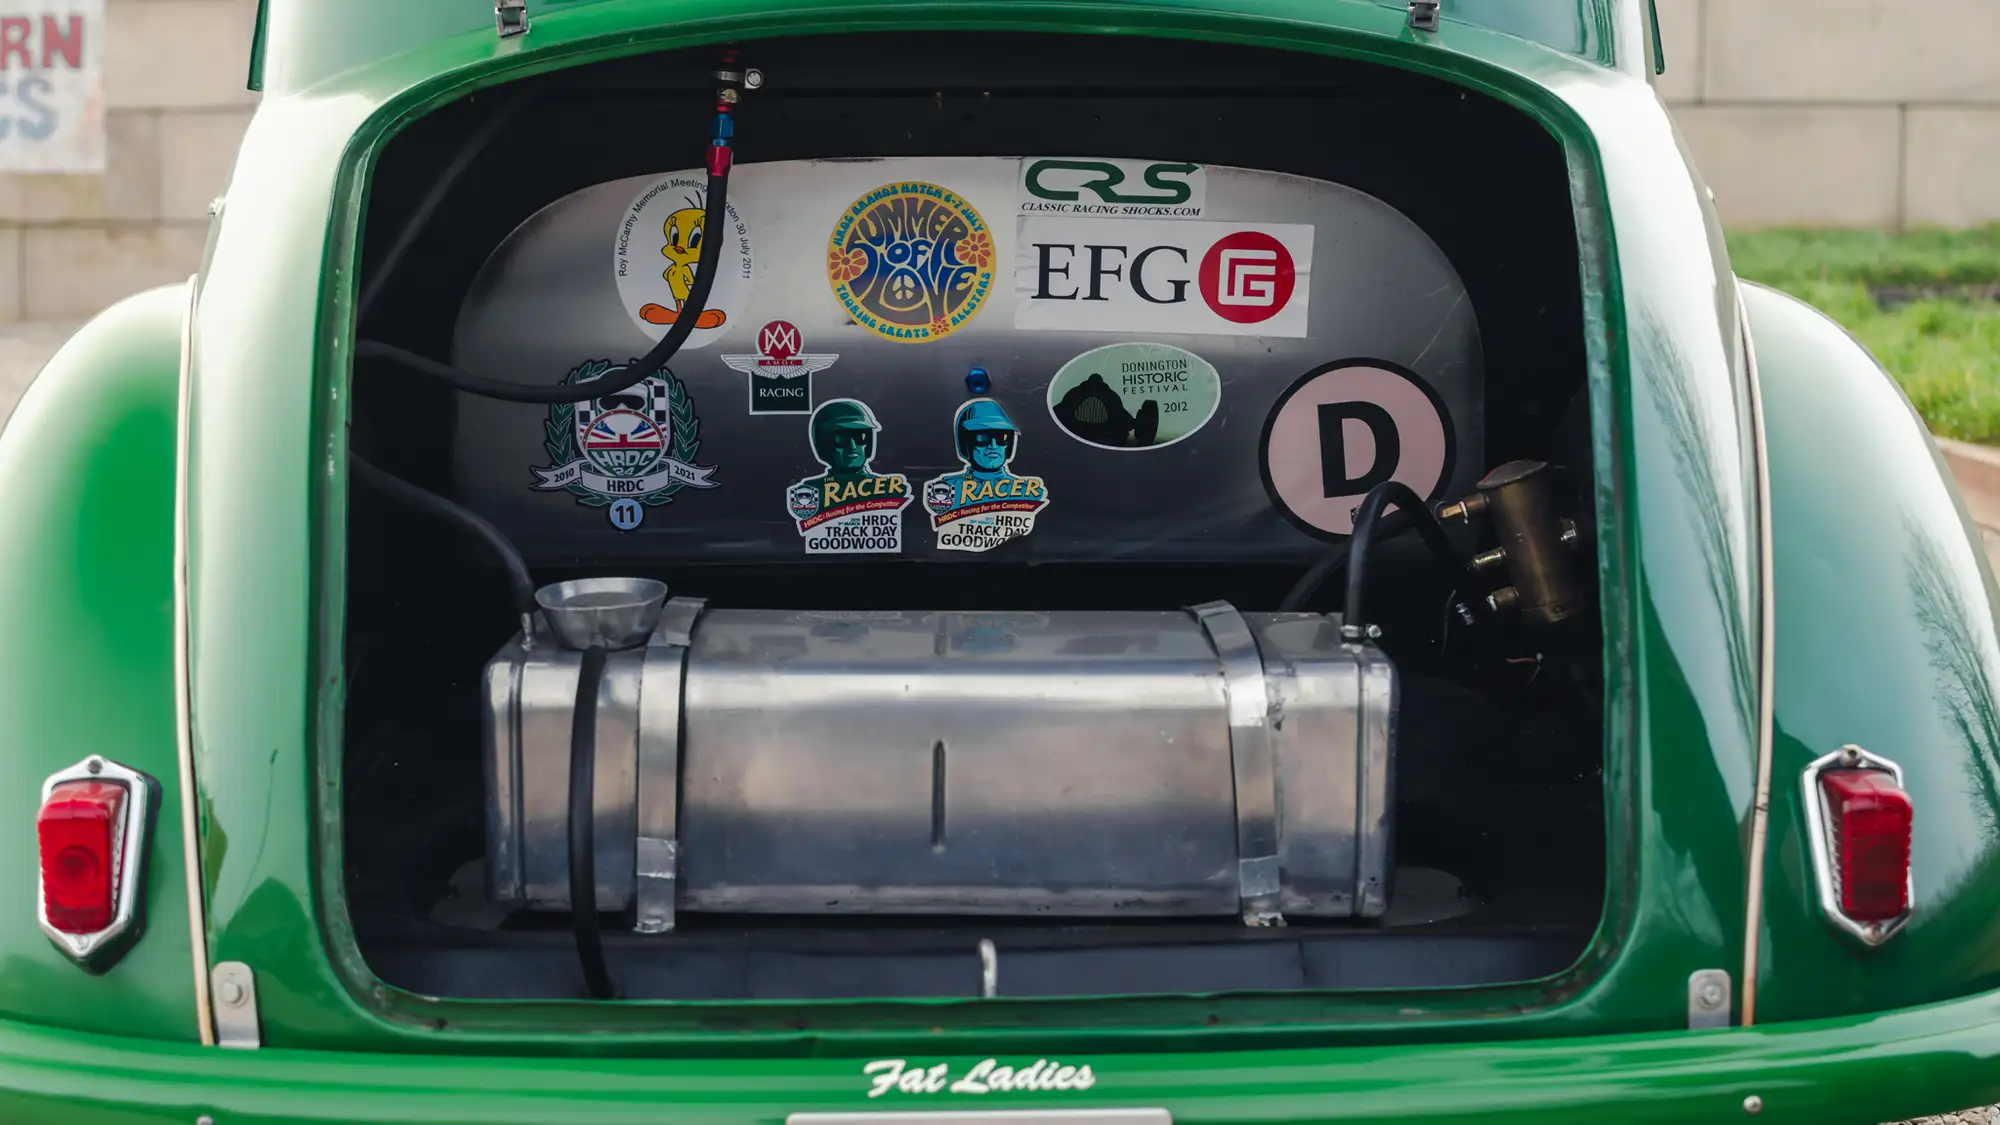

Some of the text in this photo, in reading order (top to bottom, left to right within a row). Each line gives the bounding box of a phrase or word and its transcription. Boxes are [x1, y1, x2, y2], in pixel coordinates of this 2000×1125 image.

[671, 178, 708, 193] Meeting
[1025, 159, 1199, 204] CRS
[632, 181, 669, 214] Memorial
[901, 183, 943, 199] HATCH
[961, 208, 984, 232] JULY
[1021, 202, 1201, 217] CLASSIC RACING SHOCKS.COM
[618, 213, 638, 256] McCarthy
[736, 223, 747, 235] 30
[740, 237, 750, 256] July
[618, 259, 629, 277] Roy
[742, 258, 752, 279] 2011
[1031, 243, 1191, 304] EFG
[951, 272, 991, 327] ALLSTARS
[837, 284, 930, 339] TOURING GREATS
[1122, 359, 1188, 373] DONINGTON
[1122, 370, 1188, 386] HISTORIC
[759, 387, 804, 398] RACING
[1123, 384, 1188, 395] FESTIVAL
[1163, 401, 1188, 413] 2012
[1317, 400, 1400, 499] D
[591, 450, 656, 467] HRDC
[554, 468, 575, 483] 2010
[674, 465, 696, 481] 2021
[606, 479, 644, 493] HRDC
[824, 476, 905, 508] RACER
[960, 479, 1041, 505] RACER
[615, 505, 635, 523] 11
[845, 505, 855, 514] for
[856, 503, 865, 511] the
[867, 500, 900, 509] Competitor
[981, 504, 990, 512] for
[1002, 502, 1035, 510] Competitor
[861, 515, 898, 526] HRDC
[995, 515, 1031, 528] HRDC
[825, 526, 897, 537] TRACK DAY
[958, 523, 1000, 537] TRACK
[809, 537, 898, 549] GOODWOOD
[863, 1057, 1096, 1098] Fat Ladies
